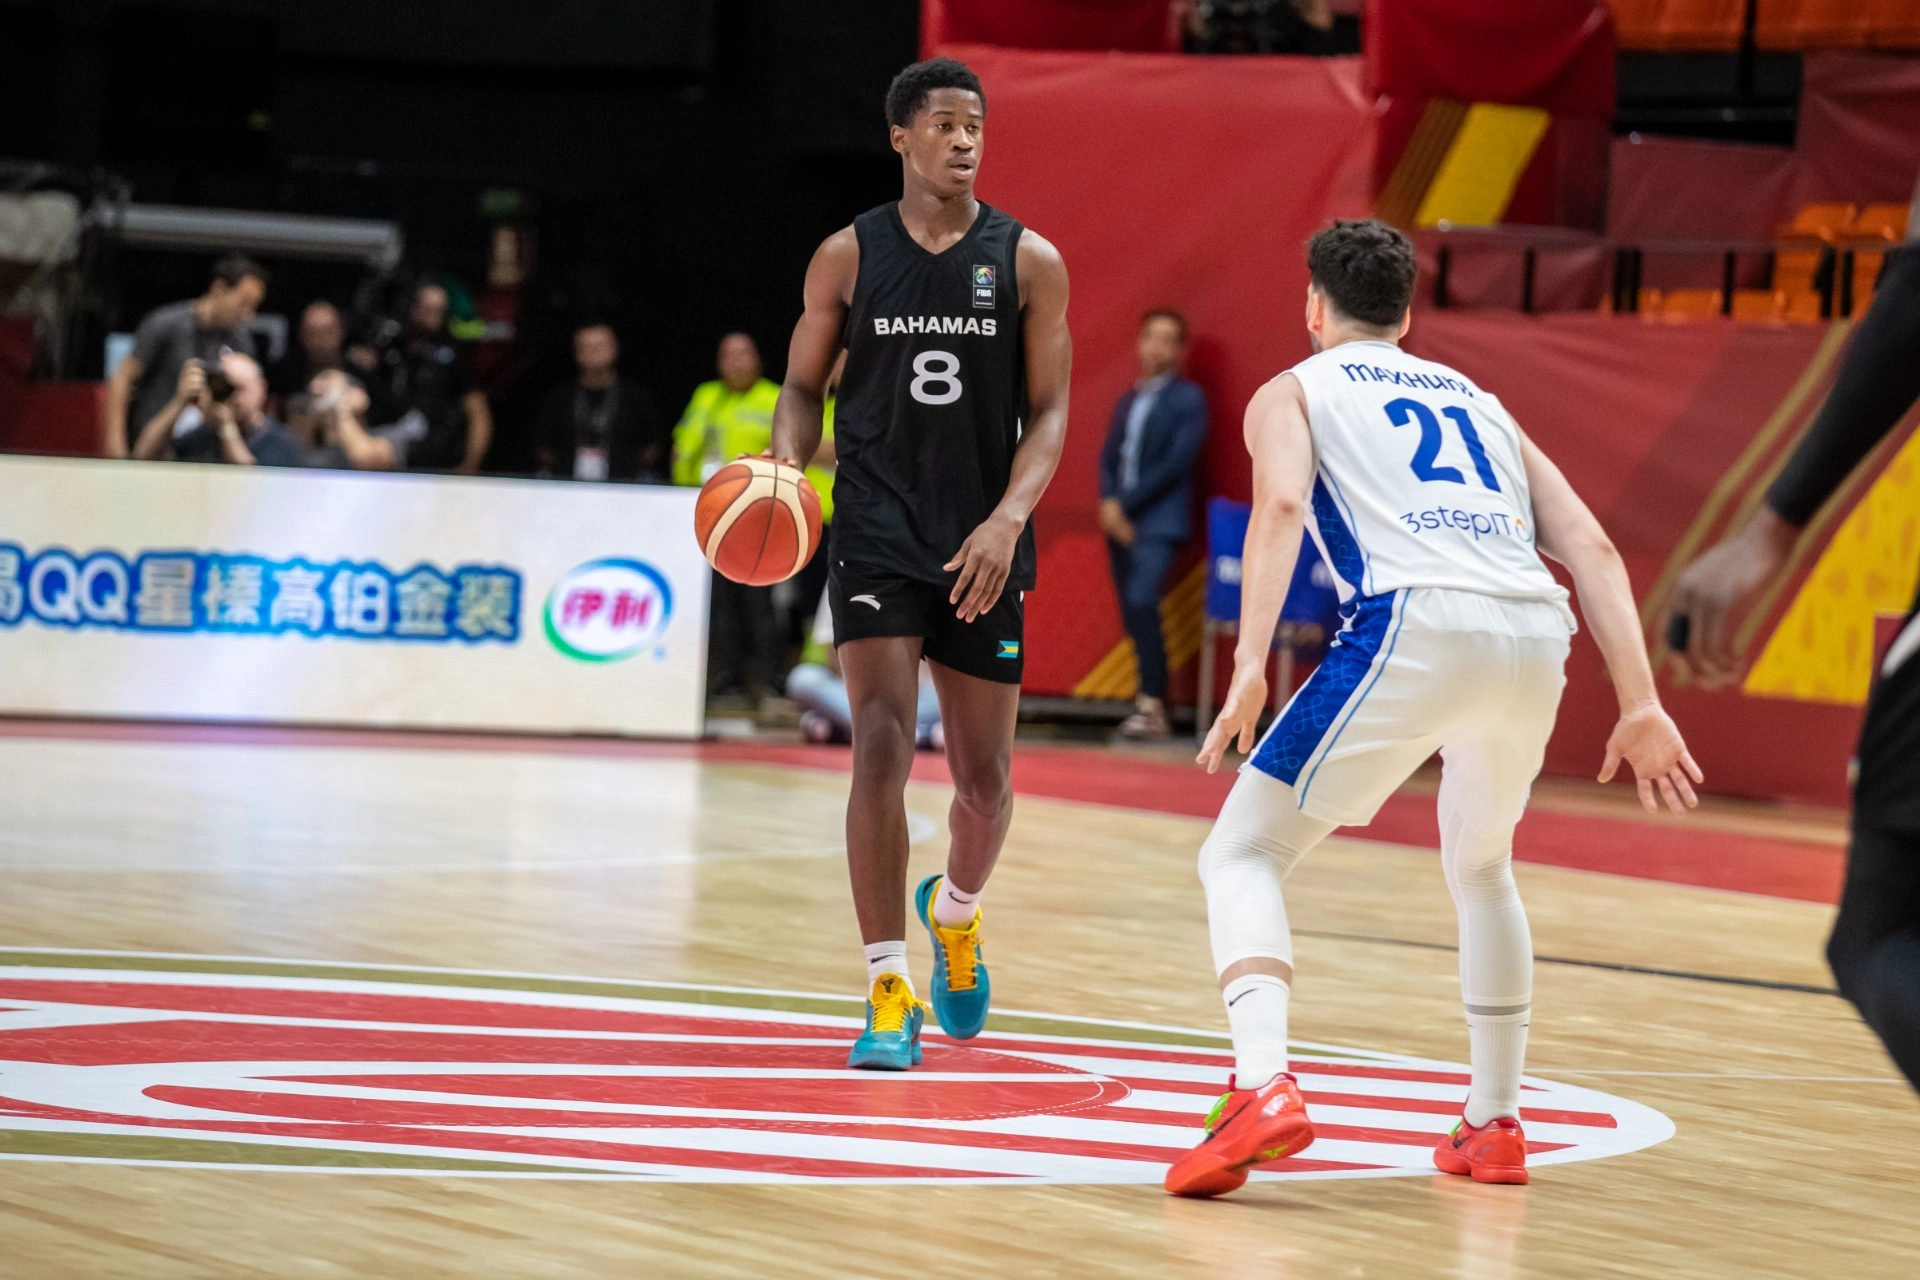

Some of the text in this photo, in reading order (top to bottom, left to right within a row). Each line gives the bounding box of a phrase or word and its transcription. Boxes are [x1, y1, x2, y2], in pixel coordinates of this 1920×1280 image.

[976, 288, 992, 298] FIBA
[874, 316, 997, 336] BAHAMAS
[910, 350, 963, 405] 8
[1383, 397, 1502, 493] 21
[561, 587, 652, 629] 伊利
